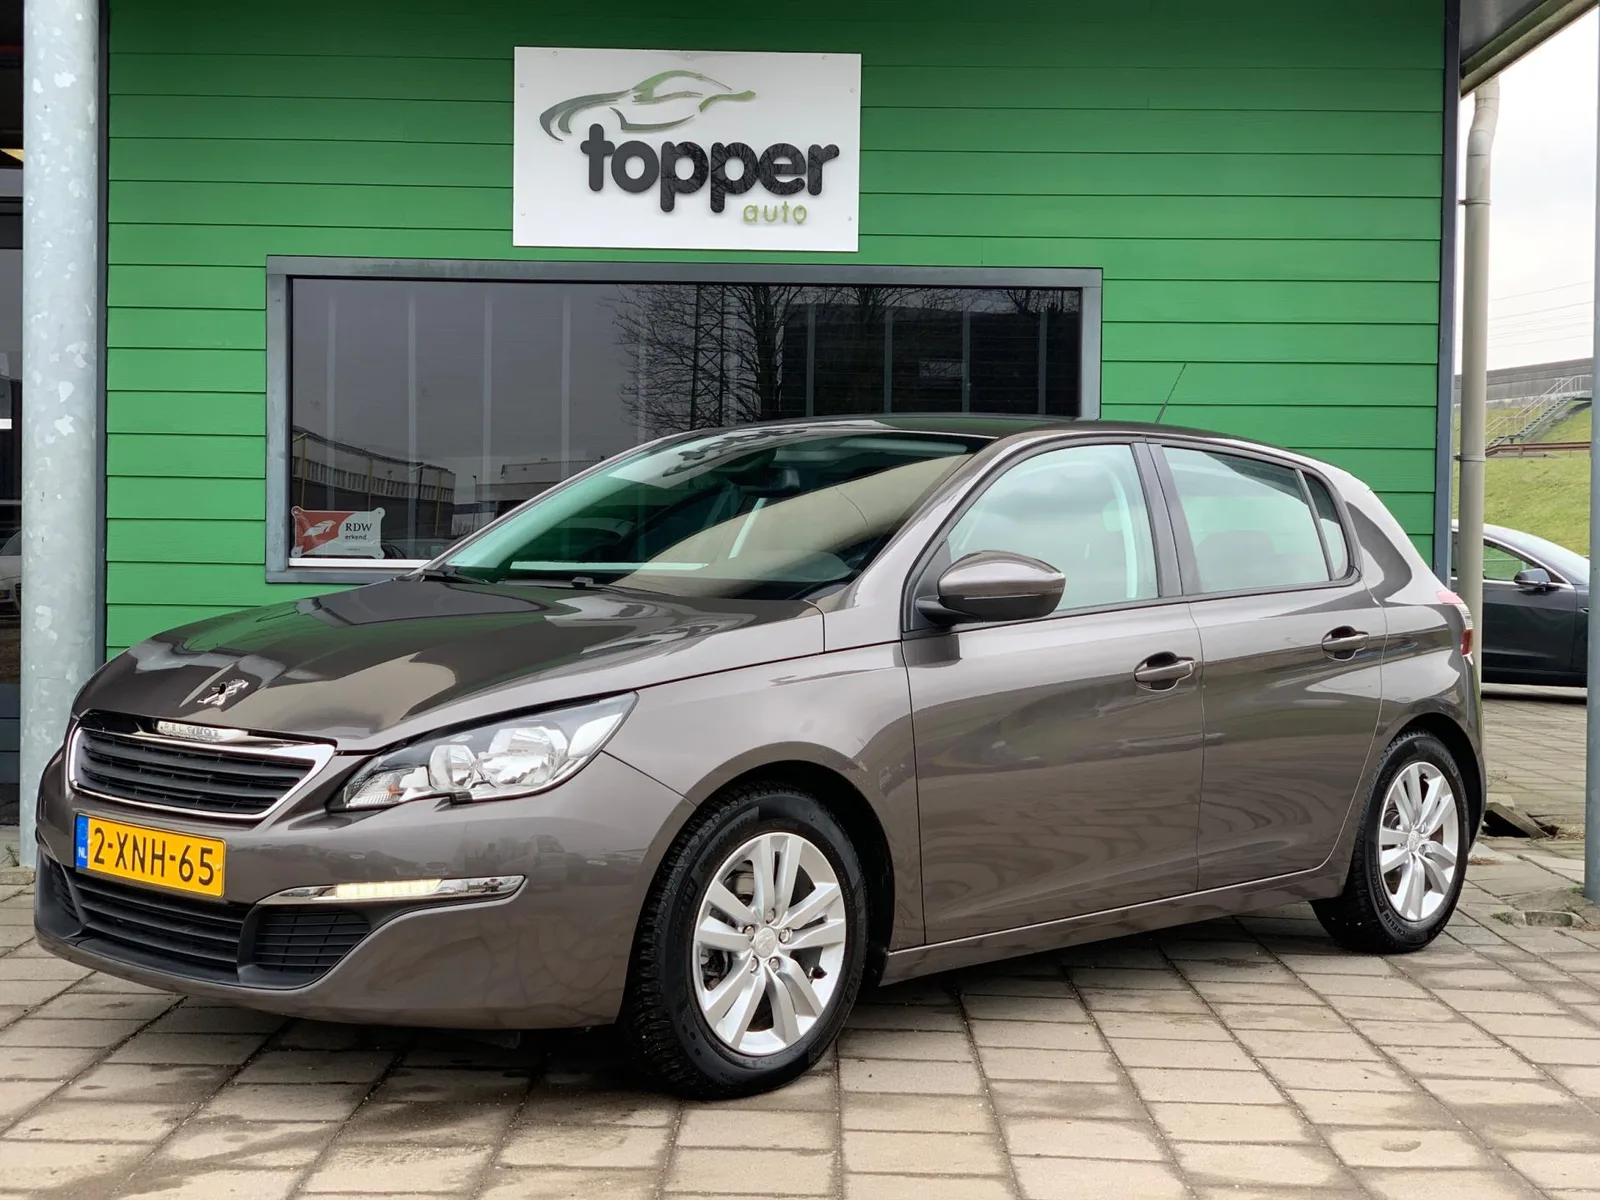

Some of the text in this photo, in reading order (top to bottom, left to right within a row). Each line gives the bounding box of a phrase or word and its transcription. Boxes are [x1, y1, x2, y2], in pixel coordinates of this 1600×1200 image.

[580, 123, 840, 213] topper
[743, 201, 807, 225] auto
[345, 522, 372, 532] RDW
[78, 846, 88, 859] NL
[93, 827, 215, 886] 2-XNH-65
